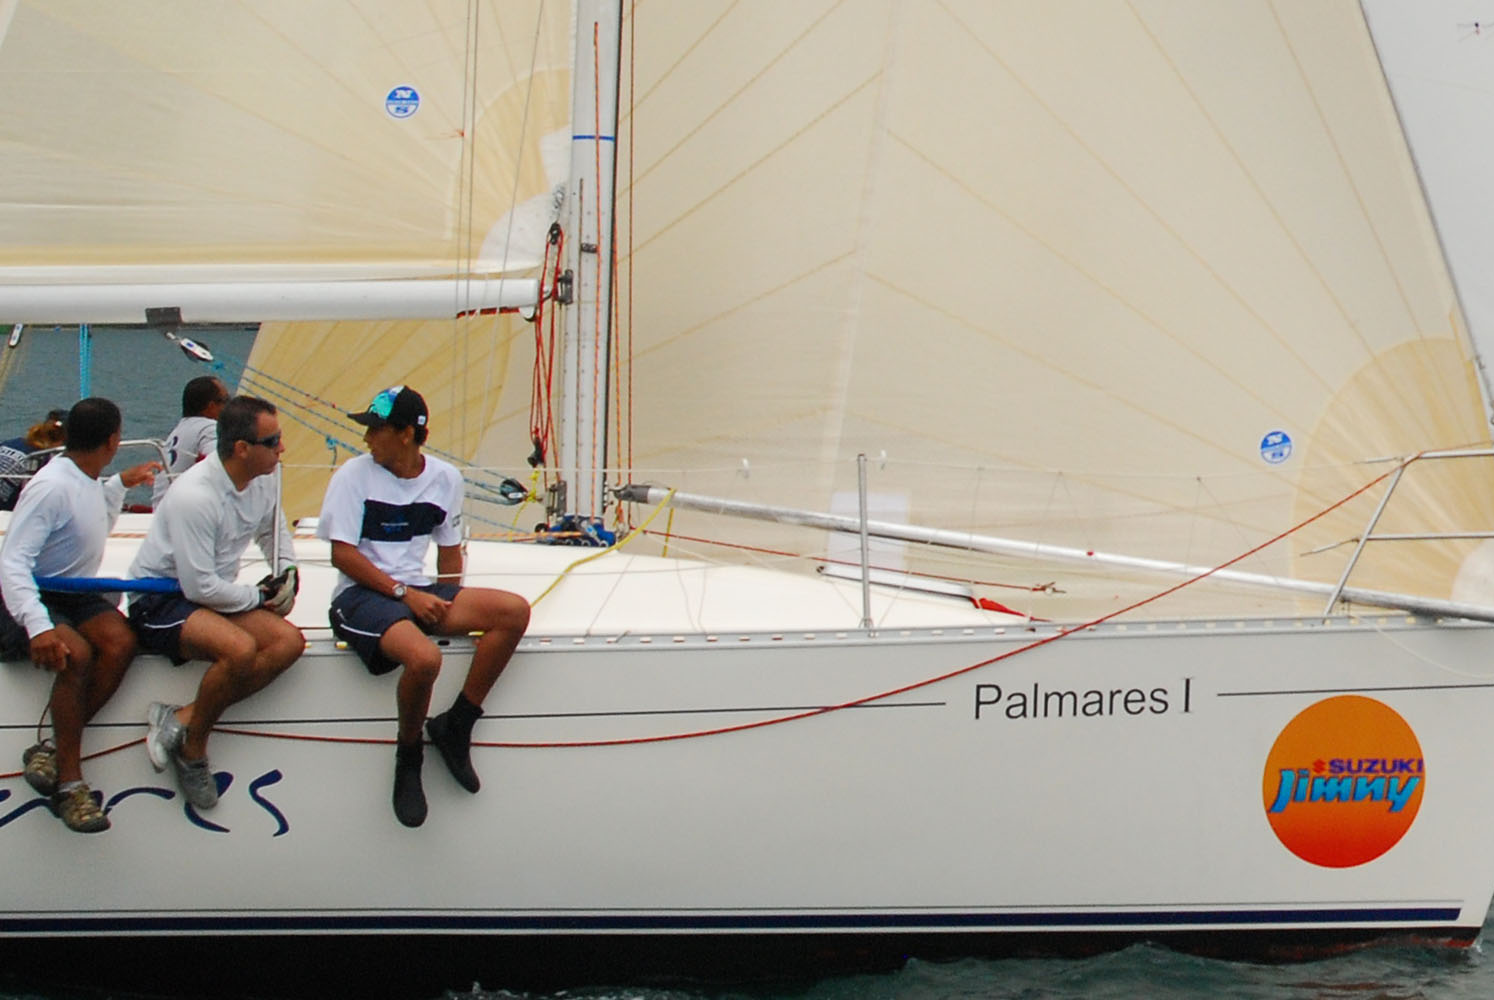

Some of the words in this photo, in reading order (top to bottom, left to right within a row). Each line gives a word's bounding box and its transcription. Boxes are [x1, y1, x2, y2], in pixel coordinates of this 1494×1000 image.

[974, 682, 1170, 721] Palmares
[1328, 758, 1424, 775] SUZUKI
[1267, 768, 1422, 814] Jimny
